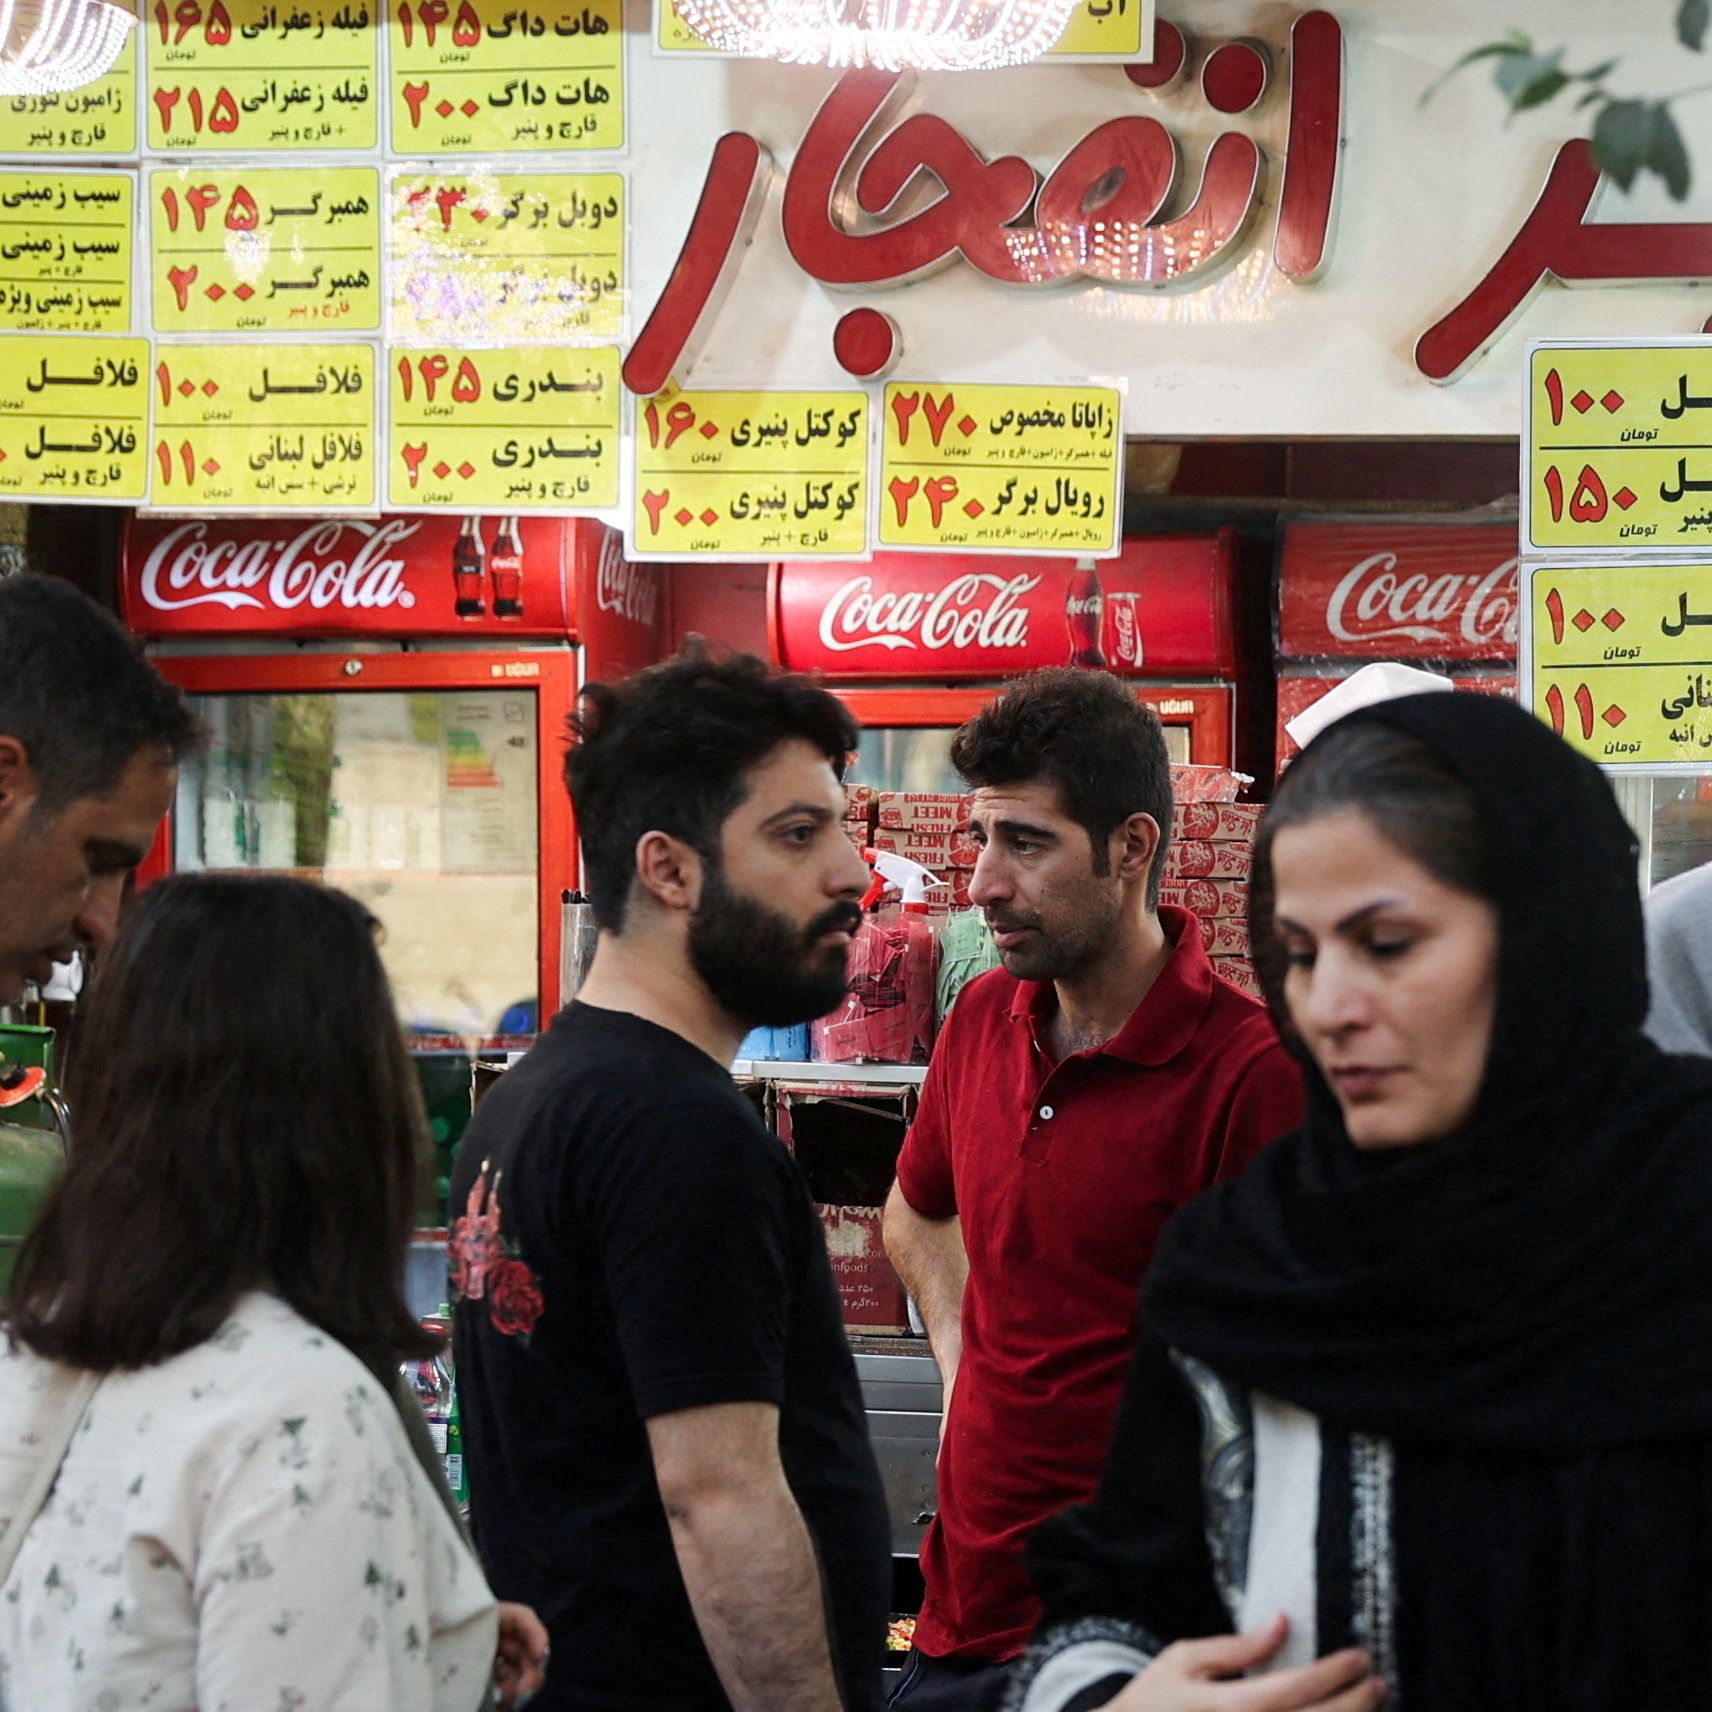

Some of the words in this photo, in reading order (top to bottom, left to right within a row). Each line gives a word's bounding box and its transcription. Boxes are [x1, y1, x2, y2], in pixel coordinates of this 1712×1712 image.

[241, 75, 325, 113] زعفرانی
[332, 76, 368, 105] فیله
[153, 87, 239, 135] ۲۱۵
[160, 184, 259, 233] ۱۴۵
[265, 187, 369, 226] همبرگر
[26, 357, 138, 392] فلافل
[157, 361, 219, 407] ۱۰۰
[248, 364, 362, 402] فلافل
[398, 355, 481, 402] ۱۴۵
[492, 368, 603, 402] بندری
[1545, 368, 1625, 426] ۱۰۰
[24, 425, 137, 459] فلافل
[644, 401, 719, 450] ۱۶۰
[730, 414, 789, 449] پنیری
[794, 409, 862, 449] کوکتل
[1620, 428, 1659, 442] تومان
[157, 439, 221, 486] ۱۱۰
[312, 434, 363, 470] فلافل
[402, 441, 476, 488] ۲۰۰
[491, 432, 603, 468] بندری
[642, 488, 719, 535] ۲۰۰
[729, 487, 787, 522] پنیری
[793, 481, 860, 520] کوکتل
[888, 475, 985, 528] ۲۴۰
[991, 475, 1039, 516] برگر
[1044, 477, 1105, 518] رویال
[1544, 464, 1638, 523] ۱۵۰
[1620, 524, 1657, 537] تومان
[140, 518, 423, 611] Coca-Cola
[817, 572, 1042, 652] Coca-Cola
[1326, 552, 1518, 644] Coca-C
[1545, 588, 1625, 645] ۱۰۰
[1603, 647, 1641, 659] تومان
[1545, 683, 1627, 740] ۱۱۰
[911, 806, 952, 819] MEET
[905, 835, 945, 848] MEET
